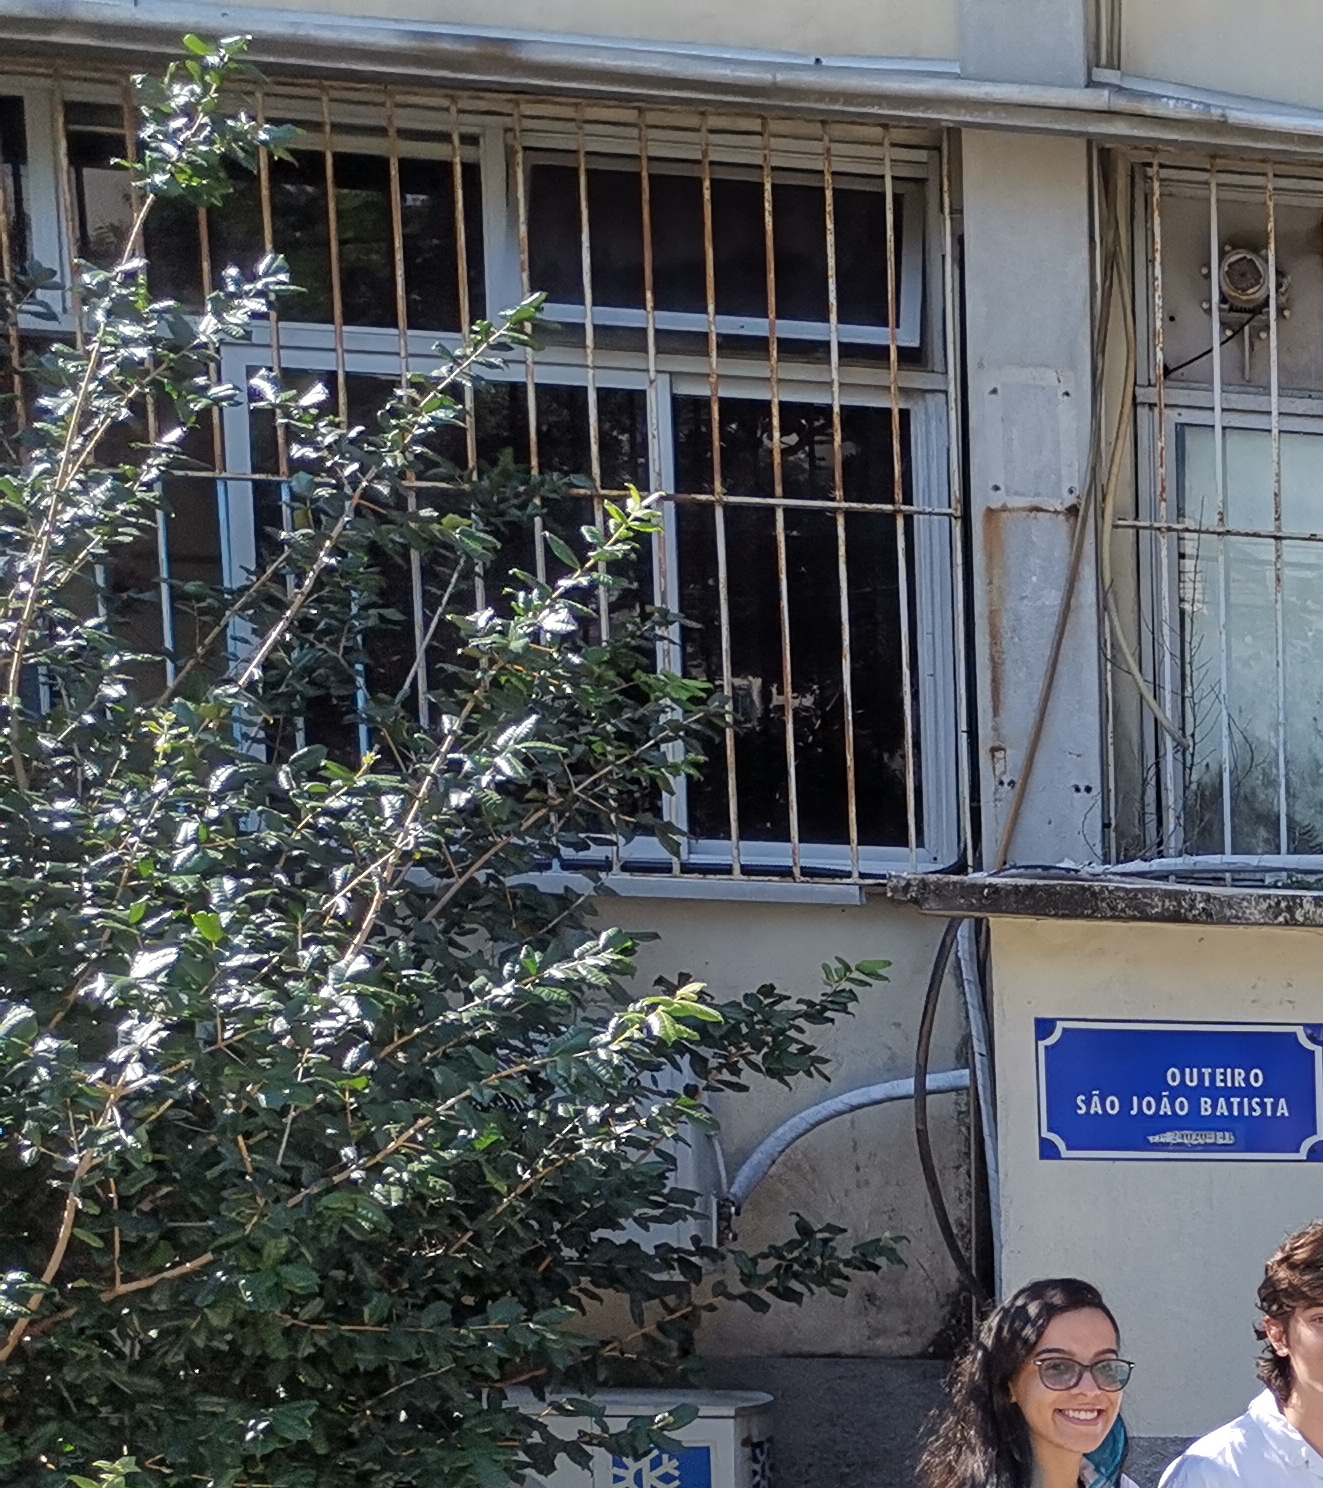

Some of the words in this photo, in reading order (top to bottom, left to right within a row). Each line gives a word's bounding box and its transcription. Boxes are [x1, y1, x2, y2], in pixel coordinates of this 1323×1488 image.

[1166, 1067, 1264, 1088] OUTEIRO
[1076, 1090, 1120, 1115] SÃO
[1130, 1091, 1189, 1116] JOÃO
[1200, 1097, 1290, 1117] BATISTA
